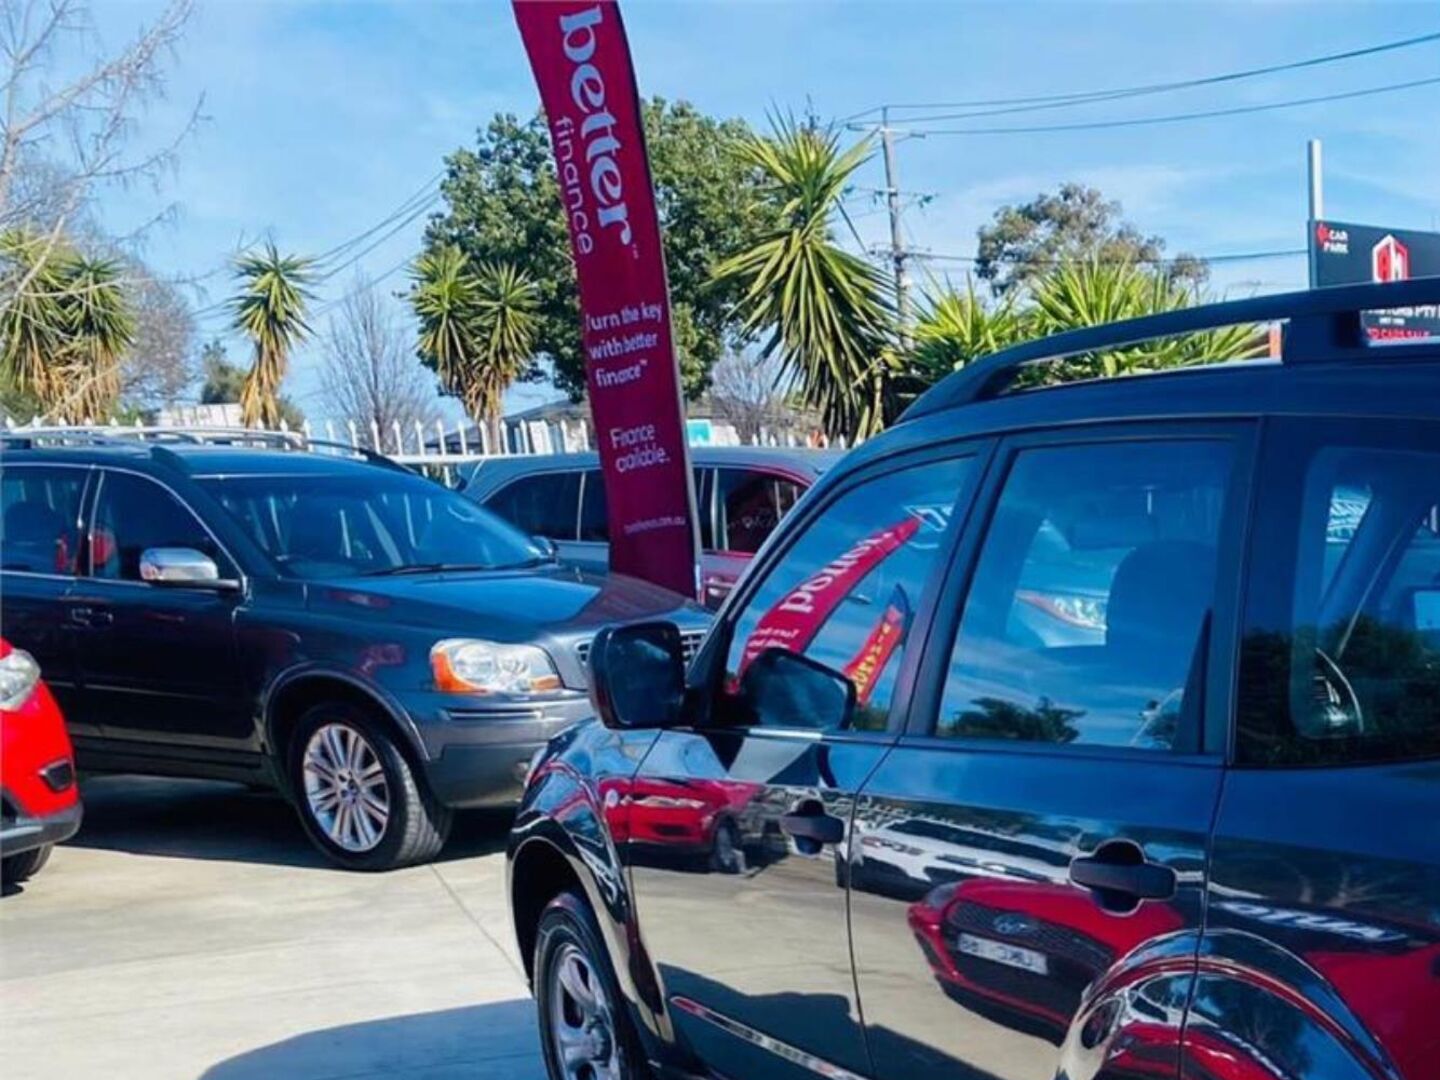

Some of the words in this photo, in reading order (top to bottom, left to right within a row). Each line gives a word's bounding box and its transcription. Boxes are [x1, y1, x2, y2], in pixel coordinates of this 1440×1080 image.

[555, 116, 593, 255] finance
[1328, 229, 1348, 240] CAR
[1323, 240, 1348, 254] PARK
[589, 337, 622, 359] with
